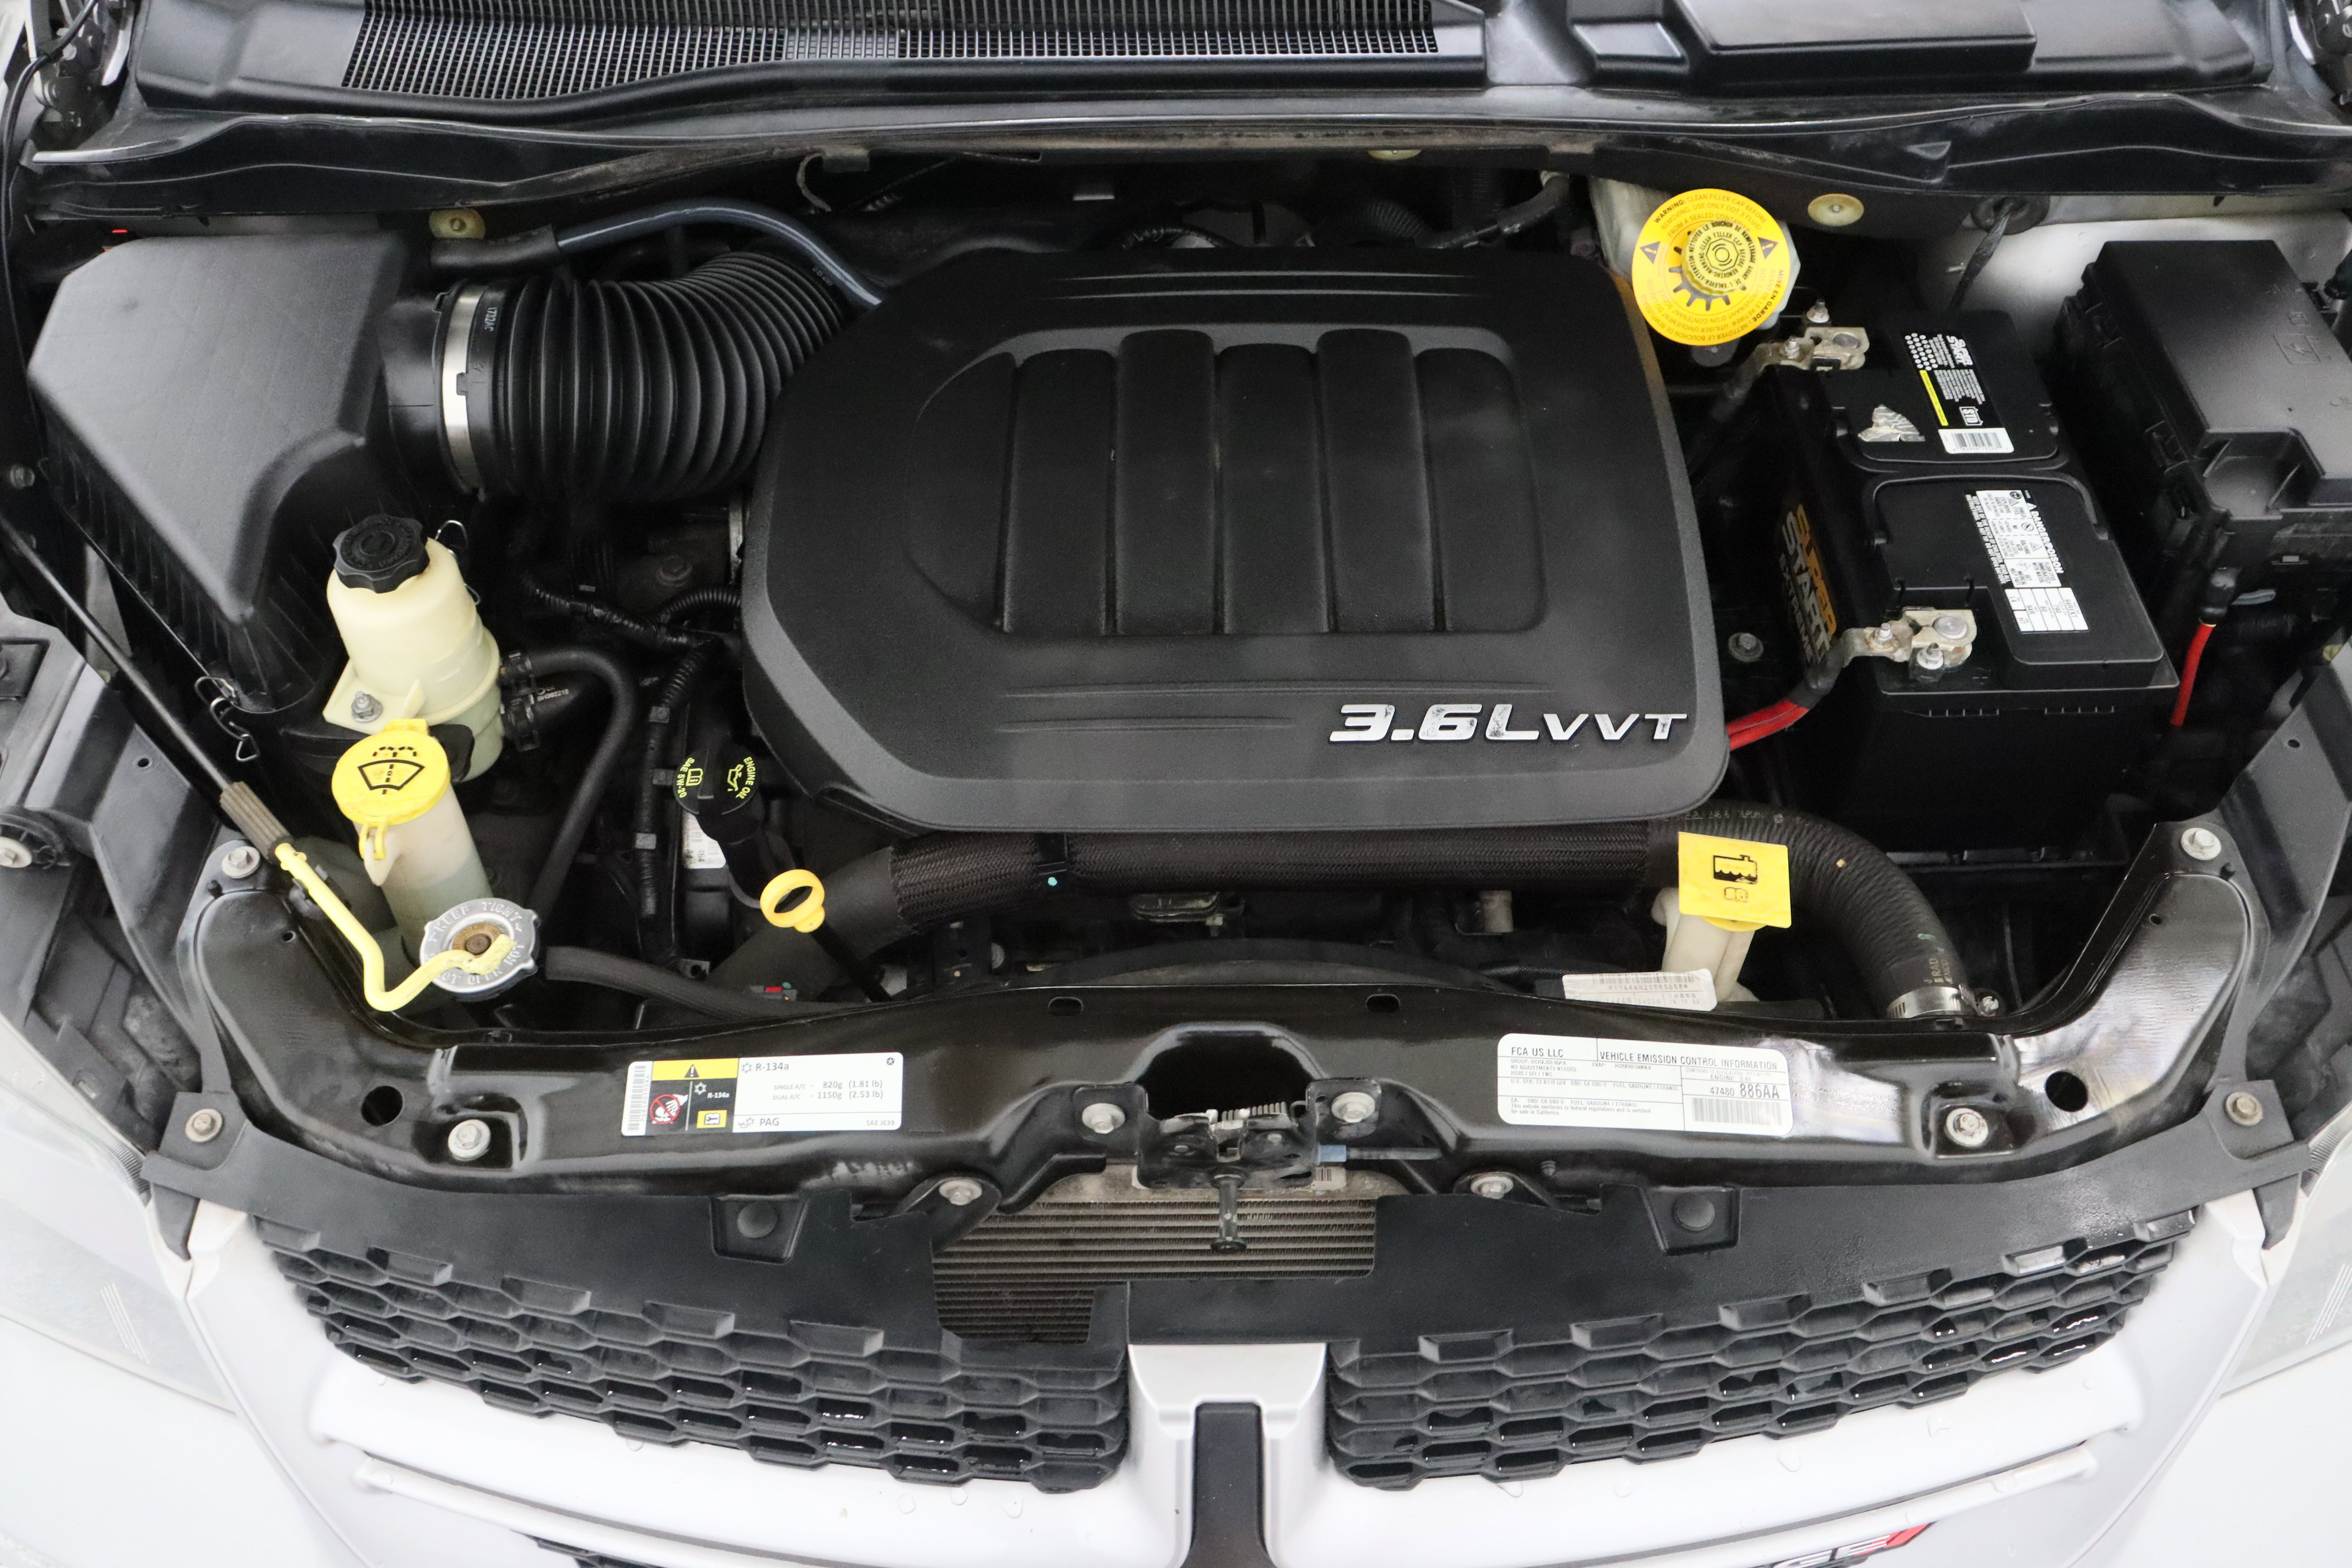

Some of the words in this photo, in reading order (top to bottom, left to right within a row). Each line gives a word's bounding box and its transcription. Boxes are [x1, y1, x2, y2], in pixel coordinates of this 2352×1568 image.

[1654, 199, 1686, 224] WARNING:
[1687, 194, 1707, 203] CLEAN
[1732, 198, 1744, 207] CAP
[1746, 204, 1767, 223] BEFORE
[1668, 222, 1684, 237] FROM
[1690, 213, 1713, 222] SEALED
[1726, 205, 1739, 214] DOT
[1745, 214, 1762, 230] FLUID
[1733, 237, 1742, 246] CAP
[1770, 290, 1778, 300] EN
[1329, 704, 1540, 742] 3.6L
[1543, 713, 1687, 740] VVT
[680, 757, 695, 773] SAE
[743, 756, 756, 786] ENGINE
[736, 787, 750, 799] OIL
[1511, 1047, 1528, 1056] FCA
[1532, 1048, 1544, 1057] US
[1548, 1049, 1563, 1057] LLC
[1600, 1051, 1634, 1061] VEHICLE
[1638, 1054, 1677, 1064] EMISSION
[1680, 1056, 1718, 1067] CONTROL
[1721, 1059, 1777, 1070] INFORMATION
[756, 1063, 789, 1071] R-134a
[823, 1081, 842, 1089] 820g
[848, 1080, 869, 1089] (1.81
[871, 1079, 883, 1088] lb)
[1710, 1087, 1734, 1096] 47480
[1740, 1083, 1779, 1099] 886AA
[818, 1092, 842, 1100] 1150g
[849, 1090, 870, 1099] (2.53
[872, 1090, 883, 1099] lb)
[760, 1118, 779, 1126] PAG
